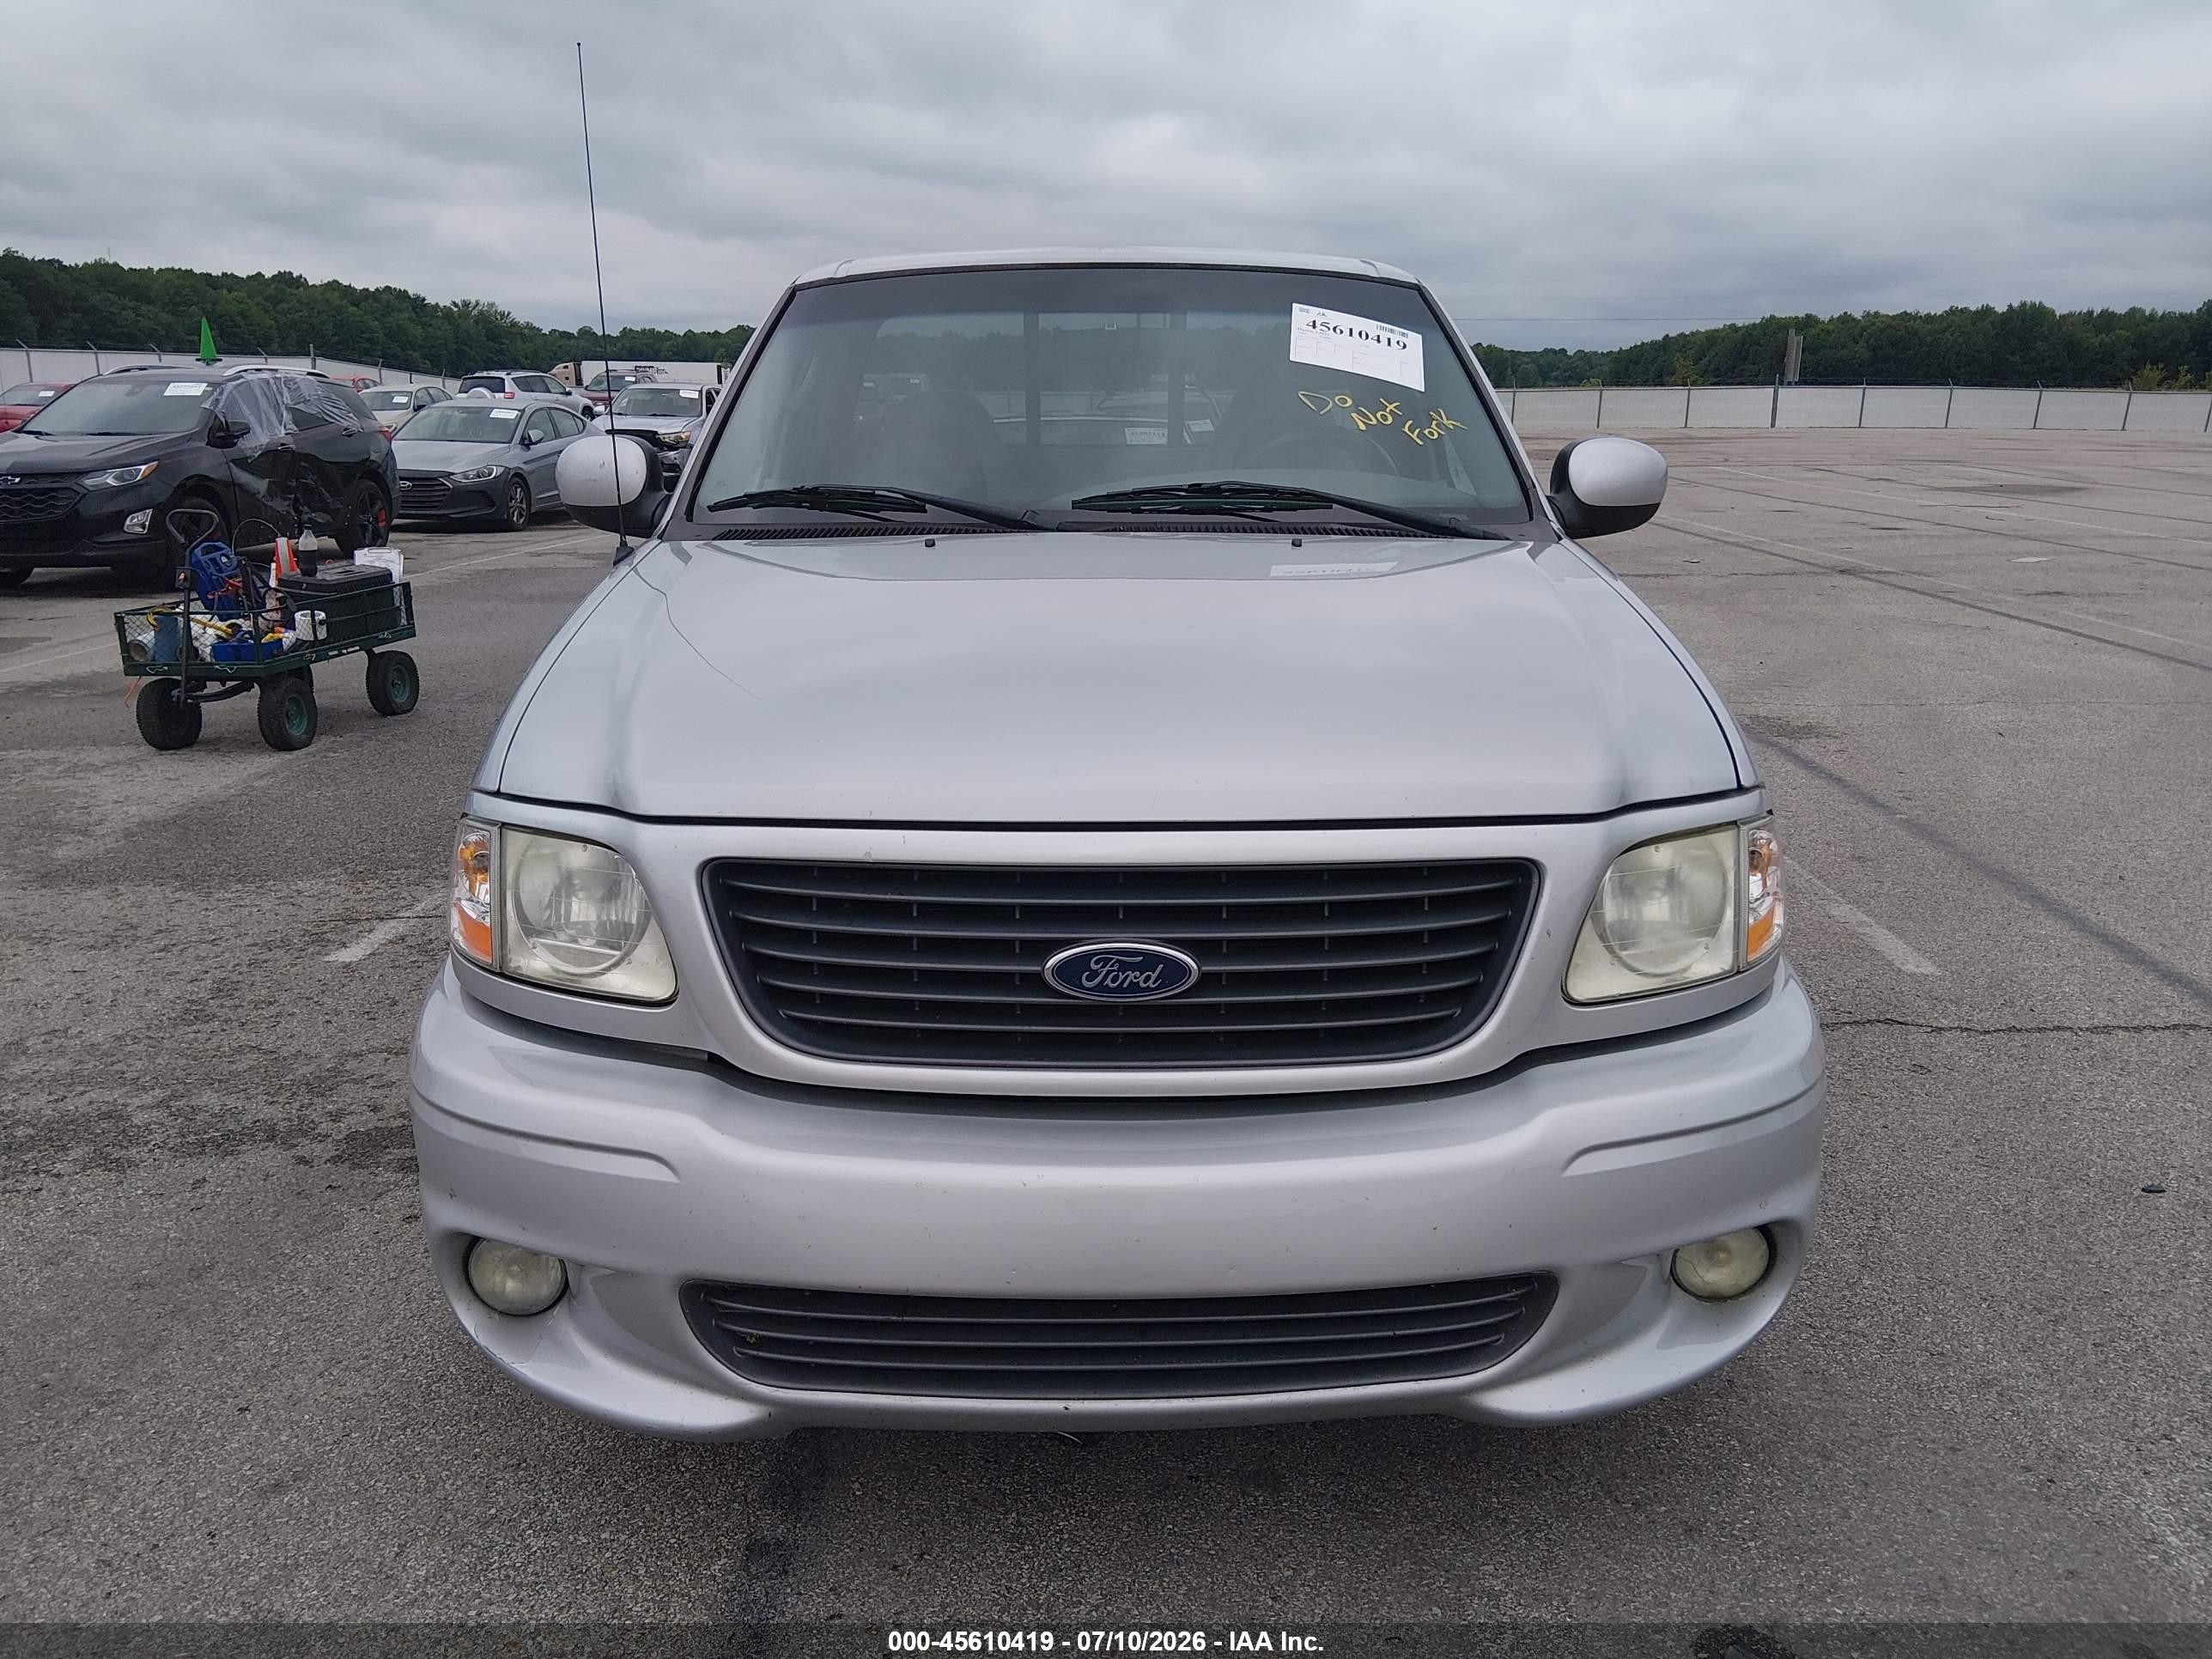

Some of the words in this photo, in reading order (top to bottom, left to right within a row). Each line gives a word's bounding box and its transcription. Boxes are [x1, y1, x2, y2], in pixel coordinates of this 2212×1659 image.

[1305, 319, 1407, 350] 45610419
[1297, 391, 1352, 415] Do
[1351, 398, 1403, 431] Not
[1401, 408, 1469, 446] Fork
[1081, 954, 1164, 988] Ford
